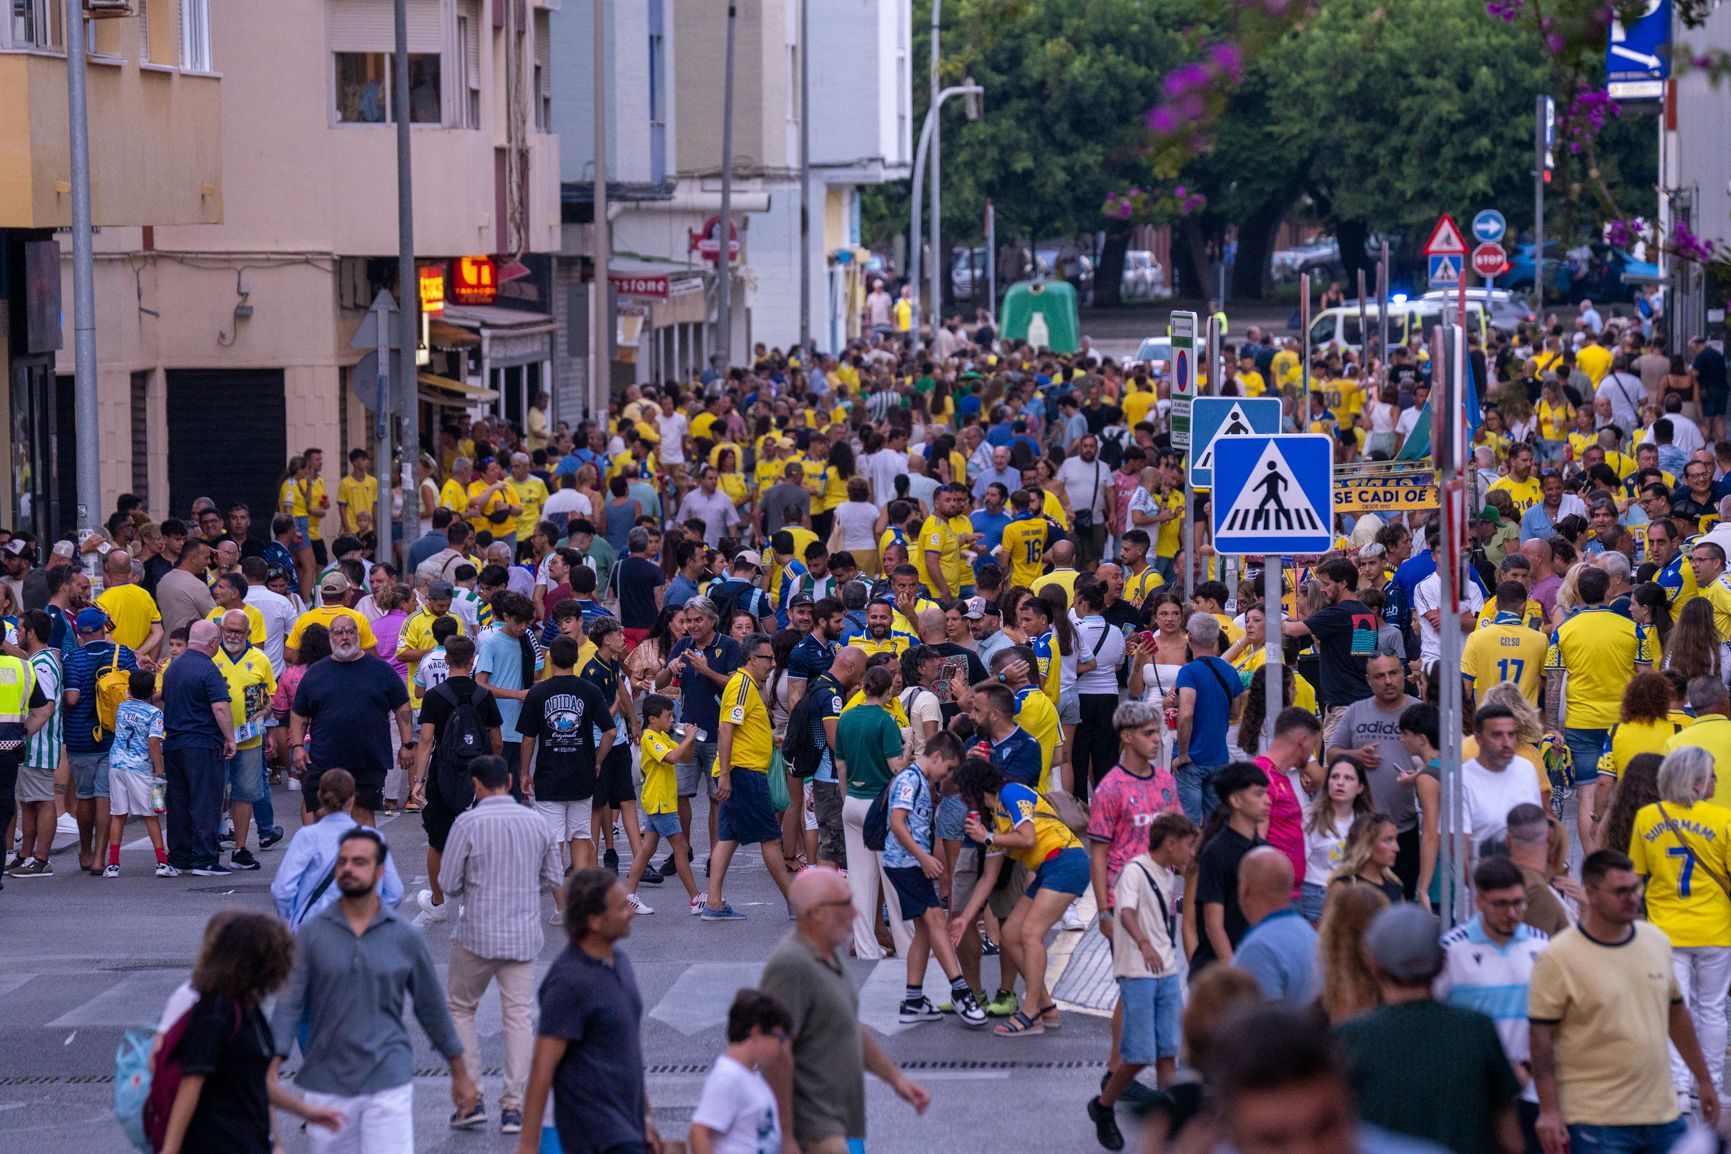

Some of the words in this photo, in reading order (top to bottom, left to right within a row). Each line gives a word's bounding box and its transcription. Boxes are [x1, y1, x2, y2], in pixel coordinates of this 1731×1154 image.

[1476, 254, 1504, 265] STOP
[455, 287, 497, 295] TABACOS
[1357, 489, 1399, 503] CADI
[1405, 486, 1427, 502] OÉ
[1024, 539, 1042, 564] 16
[1500, 637, 1521, 647] CELSO
[1498, 658, 1525, 684] 17
[544, 694, 584, 719] ADIDAS
[125, 726, 136, 752] 7
[1666, 846, 1696, 898] 7
